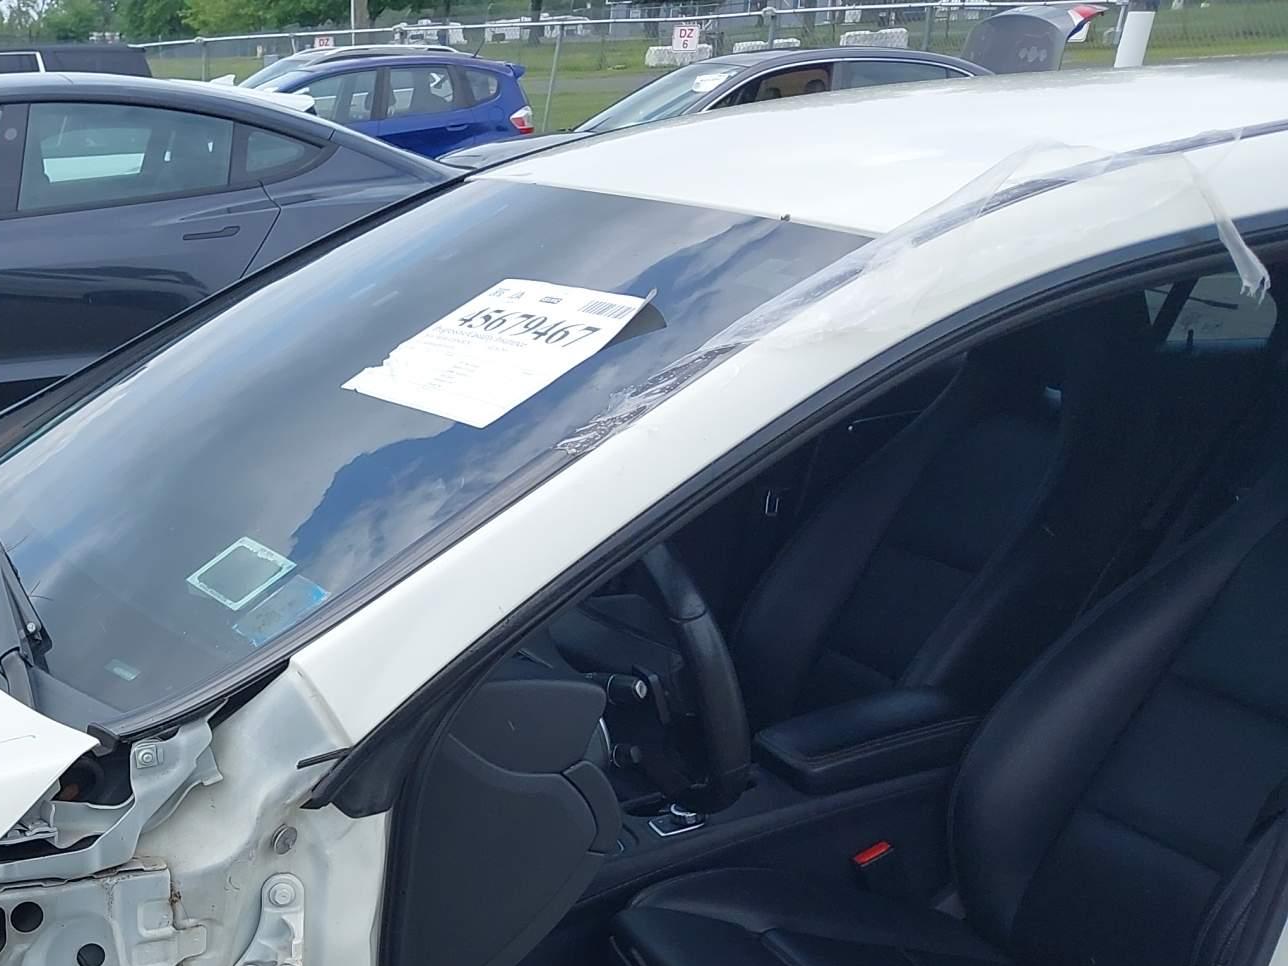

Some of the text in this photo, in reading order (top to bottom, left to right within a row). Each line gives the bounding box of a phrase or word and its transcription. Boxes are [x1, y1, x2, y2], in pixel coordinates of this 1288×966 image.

[679, 28, 694, 39] DZ
[682, 39, 689, 49] 6
[458, 307, 601, 347] 45679467
